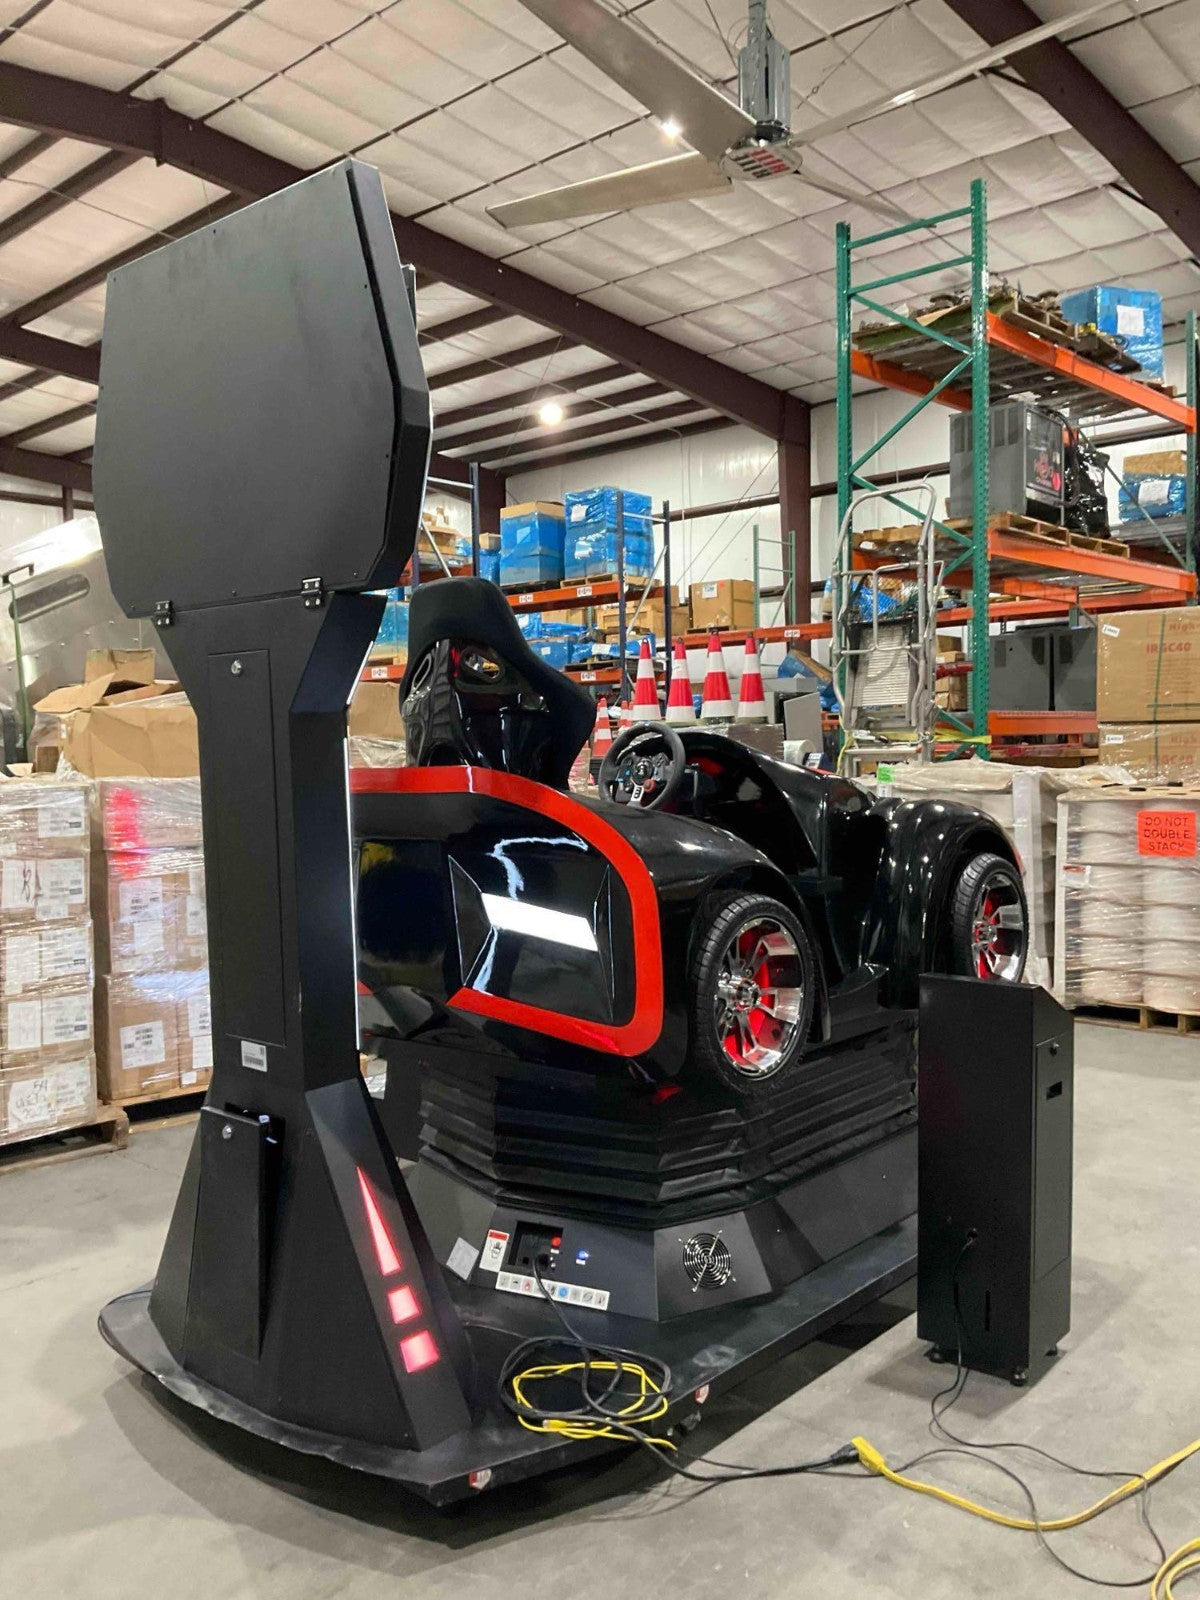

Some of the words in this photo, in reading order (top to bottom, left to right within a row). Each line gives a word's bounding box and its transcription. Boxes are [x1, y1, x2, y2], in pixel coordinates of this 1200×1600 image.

[1145, 817, 1162, 826] DO
[1166, 817, 1189, 827] NOT
[1143, 829, 1191, 839] DOUBLE
[1148, 841, 1185, 851] STACK
